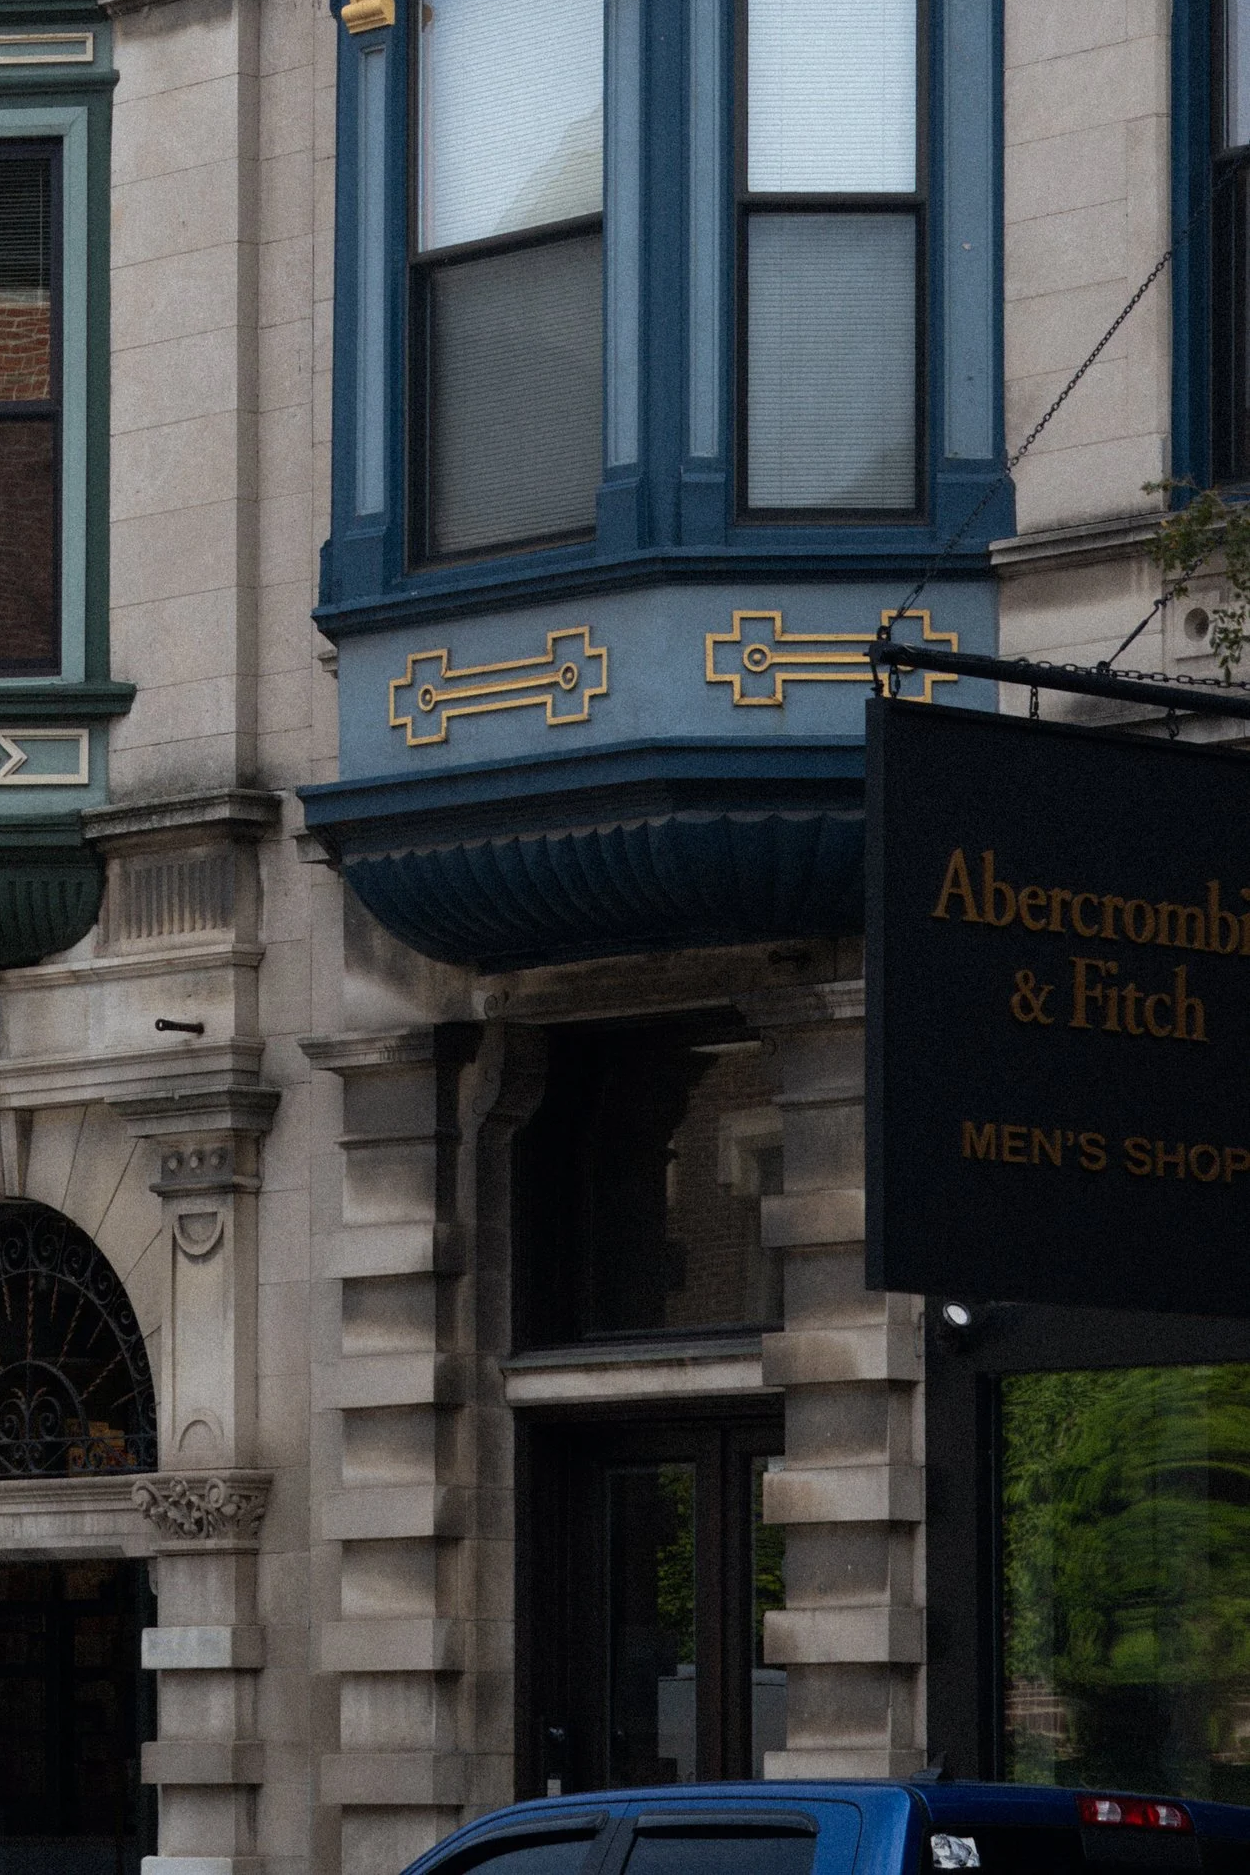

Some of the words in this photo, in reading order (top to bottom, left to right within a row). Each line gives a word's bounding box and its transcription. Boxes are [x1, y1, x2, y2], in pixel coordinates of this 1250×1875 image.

[1010, 968, 1055, 1025] &
[1068, 955, 1210, 1043] Fitch
[961, 1119, 1108, 1172] MEN’S
[1123, 1136, 1250, 1184] SHOP
